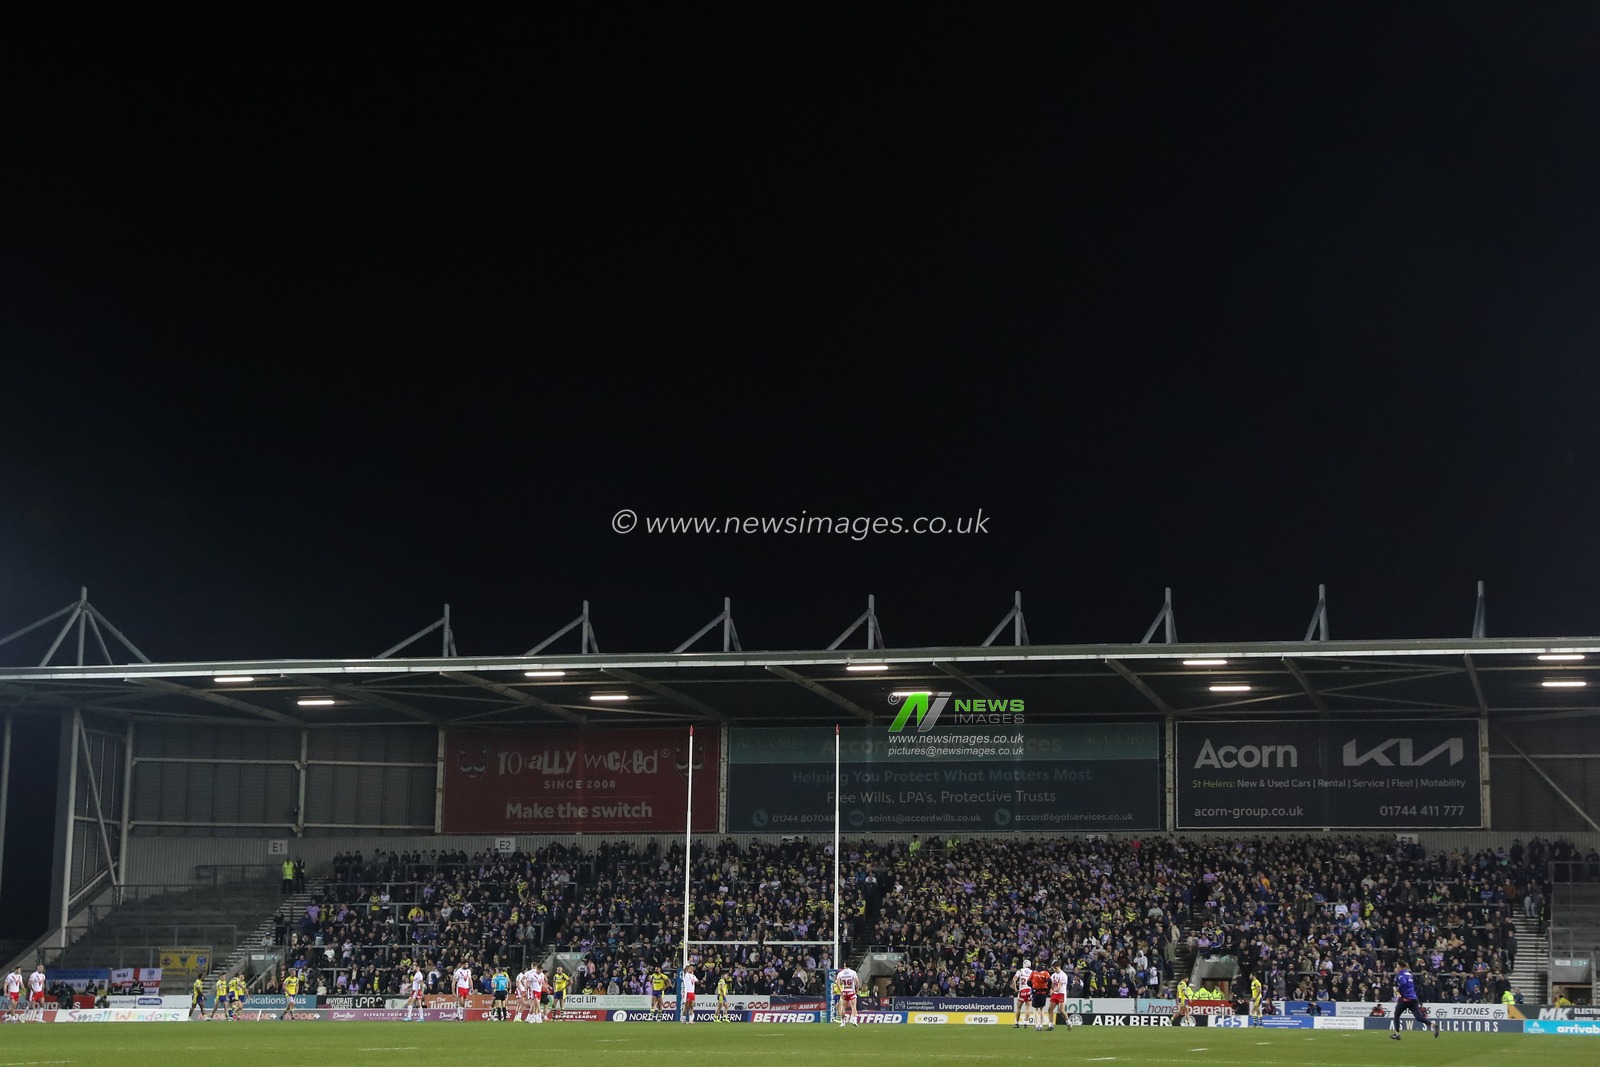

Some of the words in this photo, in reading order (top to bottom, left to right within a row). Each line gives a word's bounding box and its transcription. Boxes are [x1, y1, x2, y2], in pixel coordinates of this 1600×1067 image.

[1193, 738, 1298, 769] Acorn
[853, 769, 879, 782] You
[884, 769, 940, 782] Protect
[943, 769, 985, 782] What
[988, 768, 1050, 782] Matters
[1054, 767, 1093, 781] Most
[544, 779, 582, 789] SINCE
[586, 779, 616, 789] 2008
[1192, 779, 1201, 788] St
[1203, 779, 1236, 788] Helens:
[1237, 779, 1257, 788] New
[1259, 779, 1266, 788] &
[1267, 779, 1290, 788] Used
[1291, 779, 1311, 788] Cars
[1317, 779, 1346, 788] Rental
[1353, 779, 1385, 788] Service
[1391, 779, 1413, 788] Fleet
[1420, 778, 1466, 789] Motability
[827, 791, 856, 803] Fee
[860, 791, 895, 805] Wills,
[941, 790, 1012, 803] Protective
[1015, 790, 1056, 802] Trusts
[505, 802, 555, 819] Make
[557, 802, 588, 819] the
[591, 801, 653, 818] switch
[1194, 805, 1304, 819] acorn-group.co.uk
[1380, 805, 1417, 816] 01744
[1420, 805, 1440, 816] 411
[1443, 805, 1465, 816] 777
[772, 814, 799, 823] 01744
[869, 813, 982, 824] saints@accordwills.co.uk
[1014, 812, 1134, 823] accordlegalservices.co.uk
[272, 842, 283, 853] E1
[500, 840, 511, 850] E2
[429, 999, 473, 1009] Turmeic
[939, 1003, 1013, 1012] LiverpoolAirport.com
[1147, 1003, 1178, 1014] home
[67, 1010, 112, 1022] Small
[1453, 1007, 1490, 1016] TFJONES
[1538, 1007, 1572, 1020] MK
[752, 1012, 816, 1023] BETFRED
[1092, 1015, 1127, 1026] ABK
[1129, 1015, 1171, 1027] BEER
